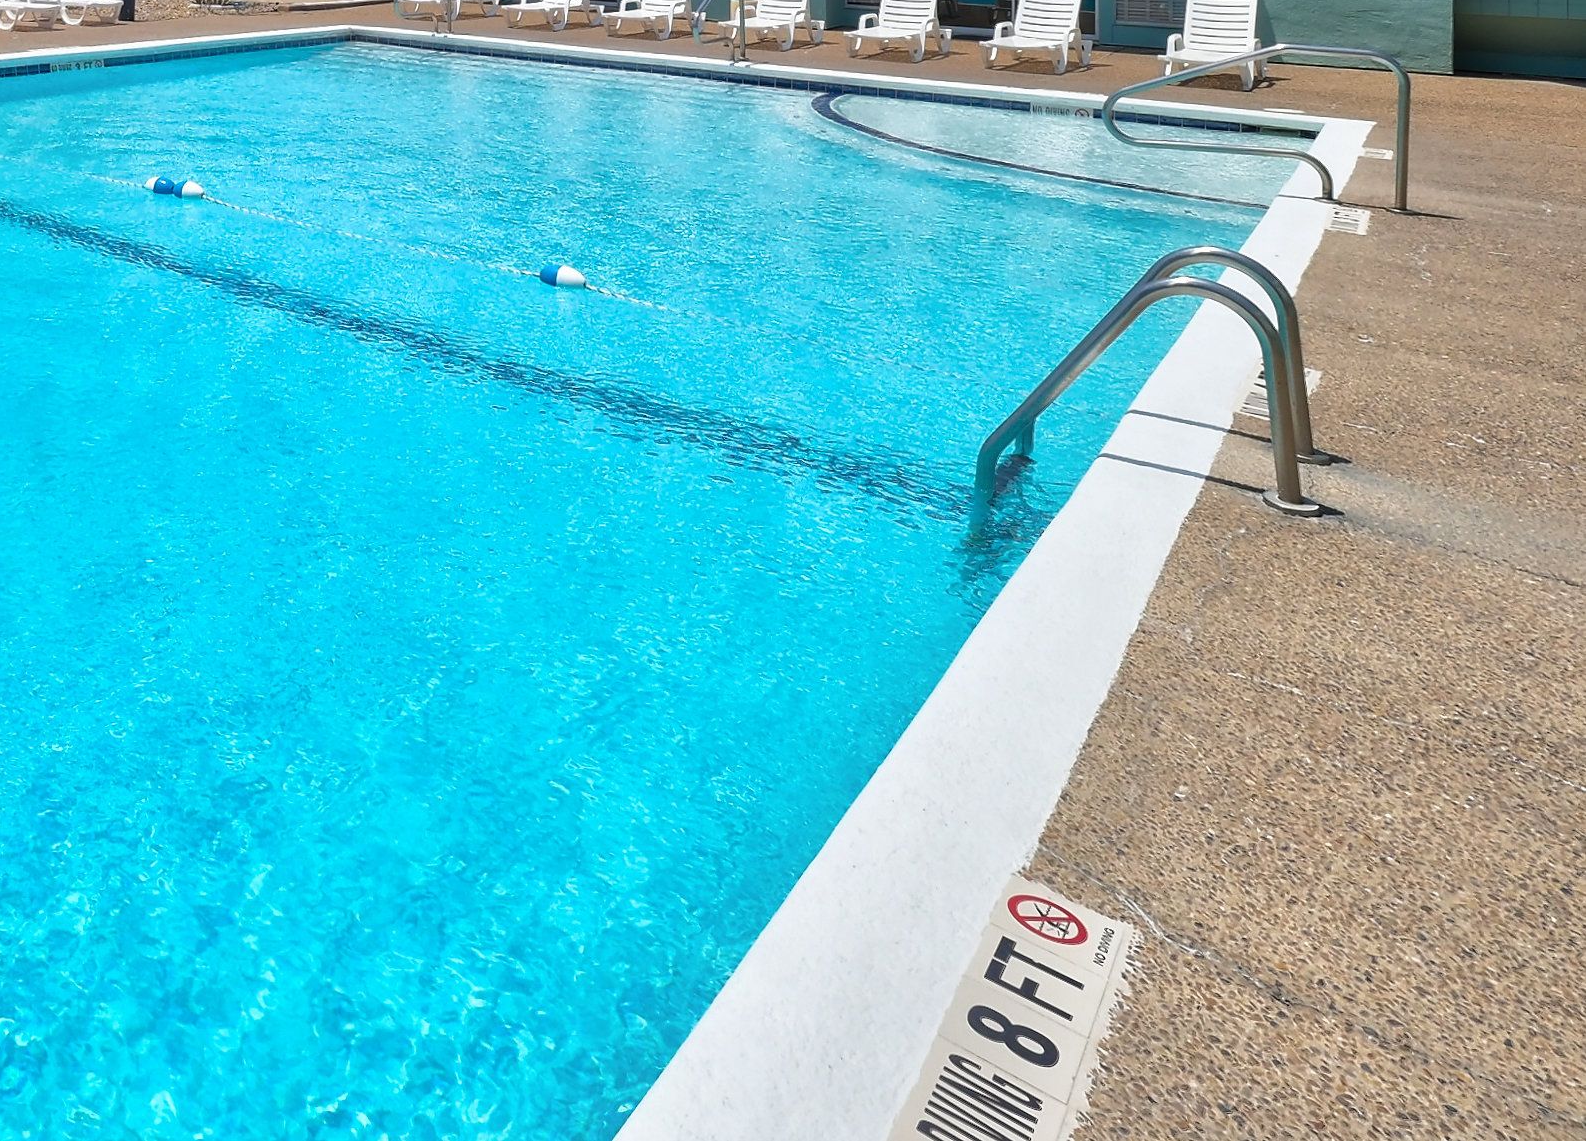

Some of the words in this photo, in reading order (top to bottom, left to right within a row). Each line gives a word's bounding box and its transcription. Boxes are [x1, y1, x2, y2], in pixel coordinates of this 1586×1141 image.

[1093, 952, 1106, 967] NO
[1097, 927, 1115, 954] DIVING
[983, 935, 1085, 1022] FT
[966, 1004, 1060, 1068] 8
[915, 1053, 1043, 1141] IVING
